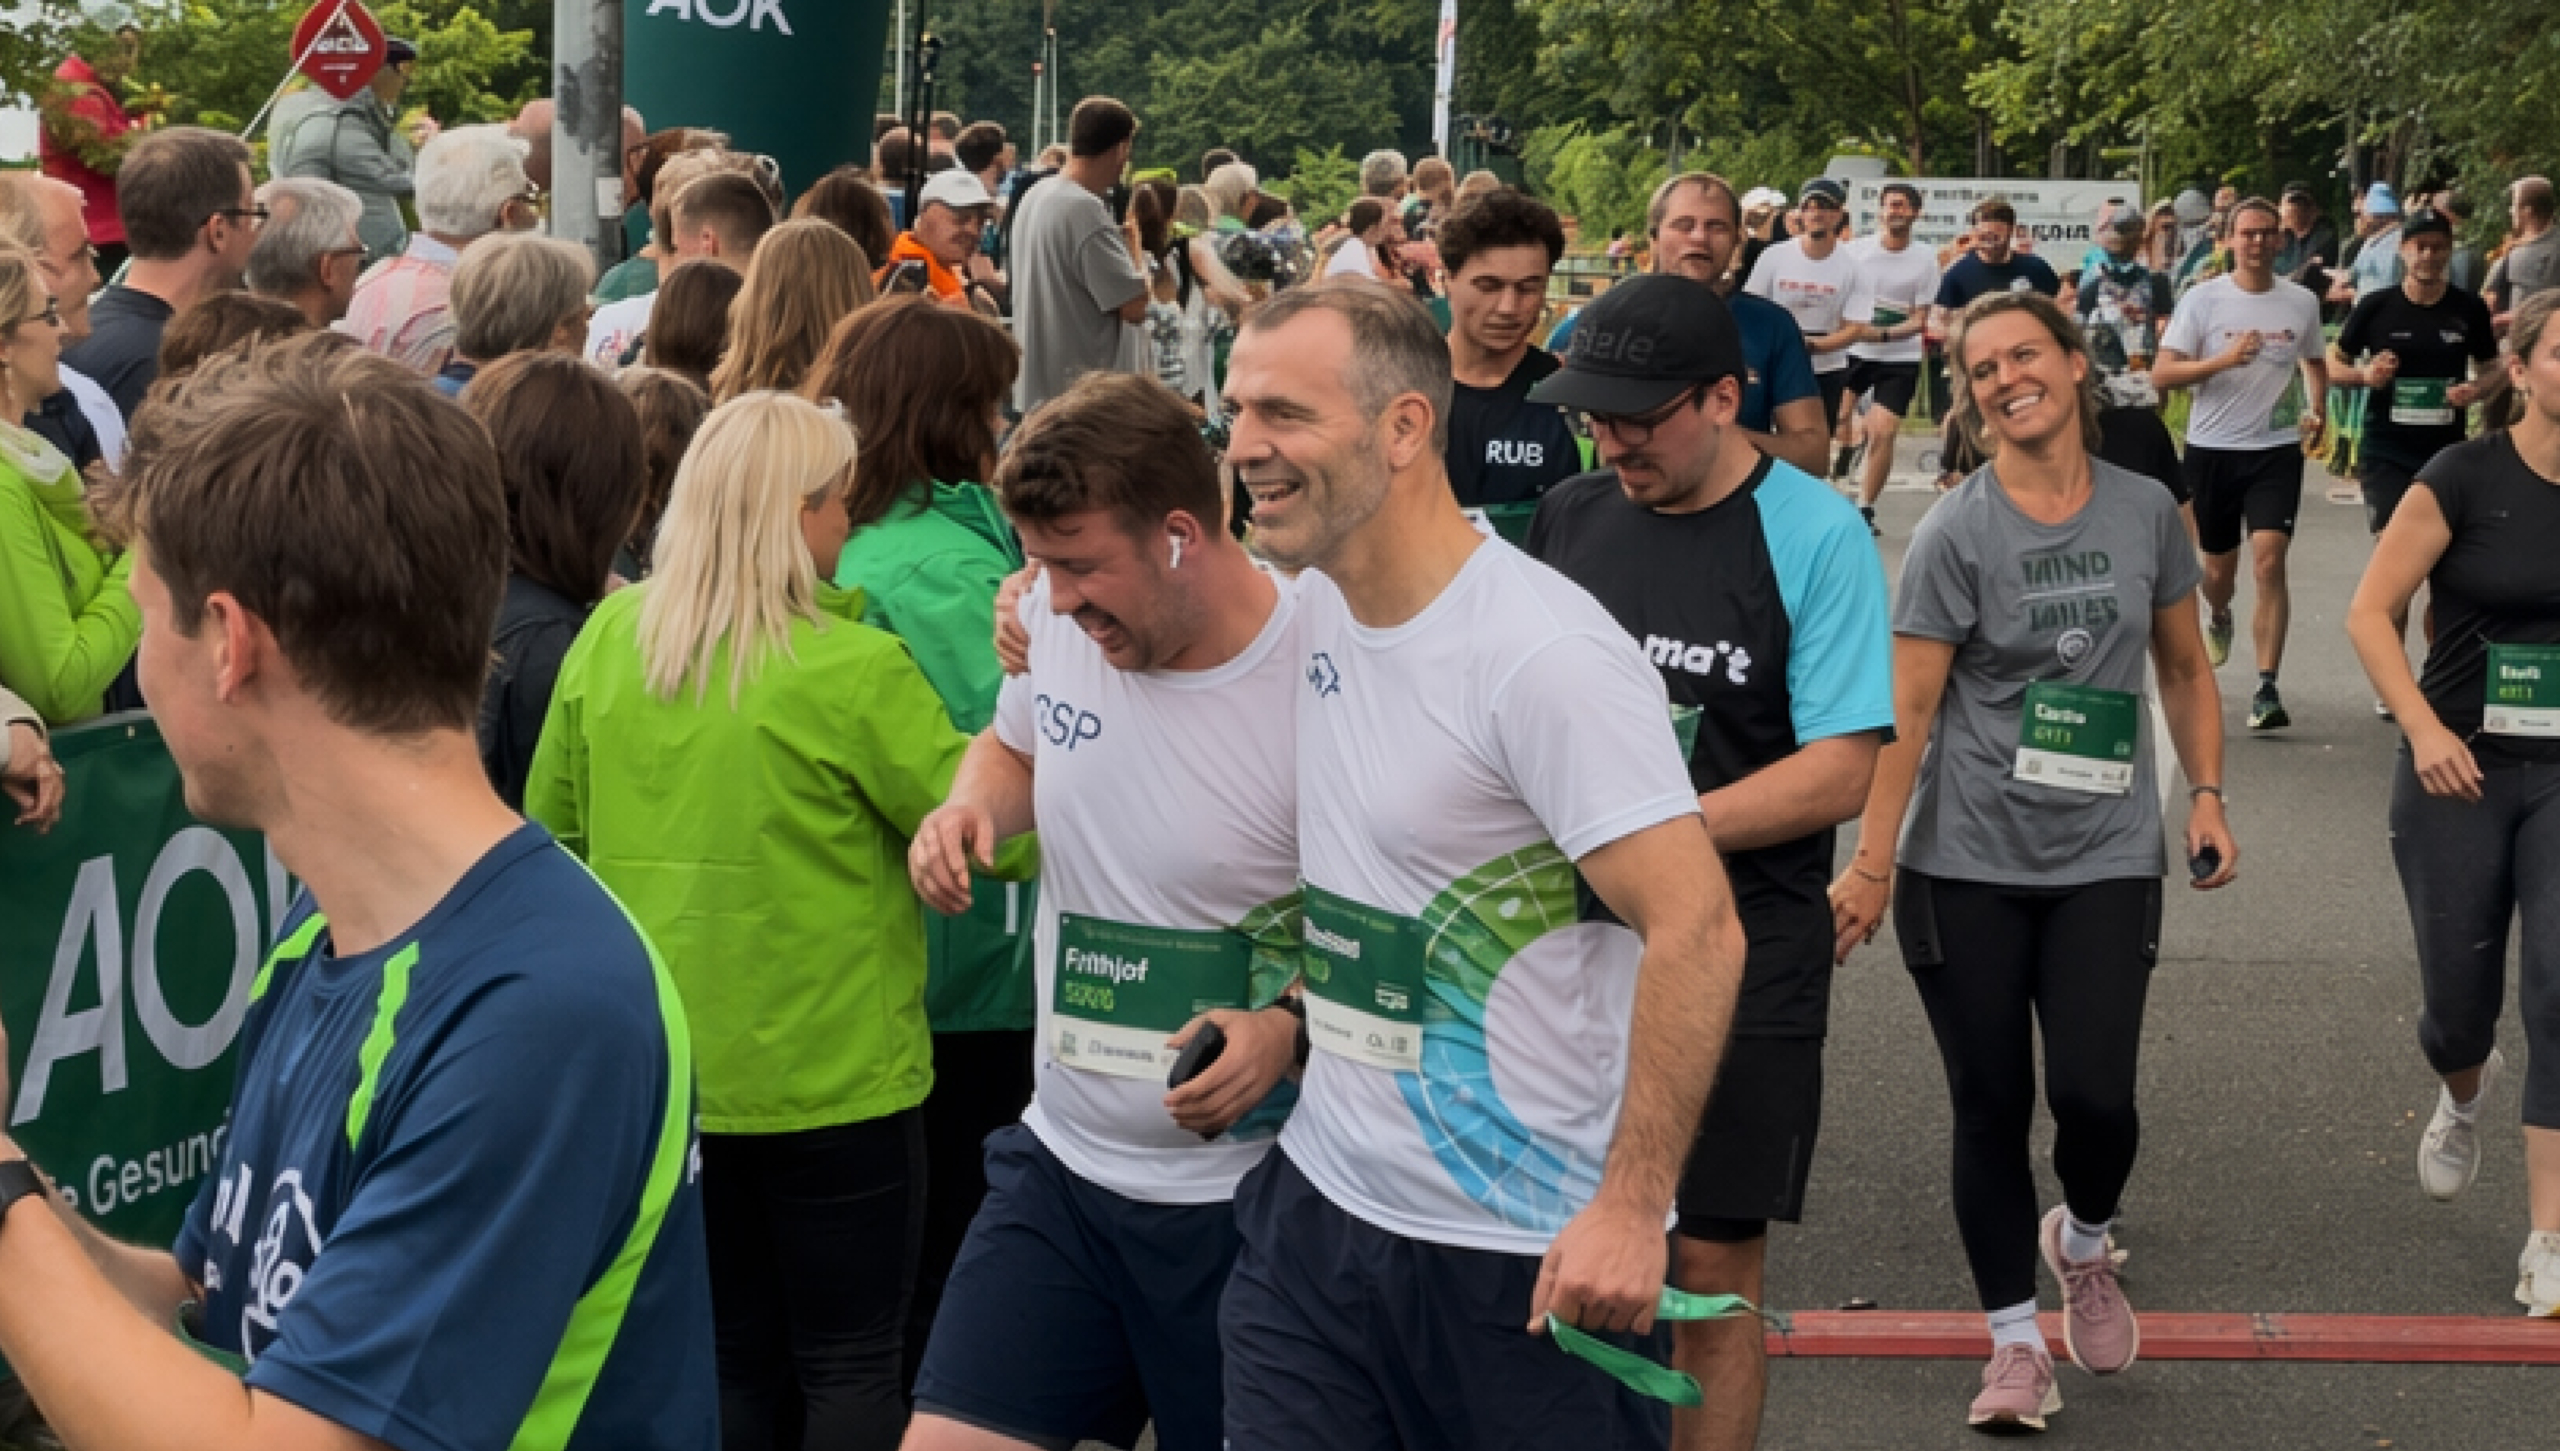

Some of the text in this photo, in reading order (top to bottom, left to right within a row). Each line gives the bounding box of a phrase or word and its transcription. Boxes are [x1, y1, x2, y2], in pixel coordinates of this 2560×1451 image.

[1485, 439, 1544, 467] RUB
[11, 826, 306, 1128] AO
[1065, 947, 1149, 985] Frithjof
